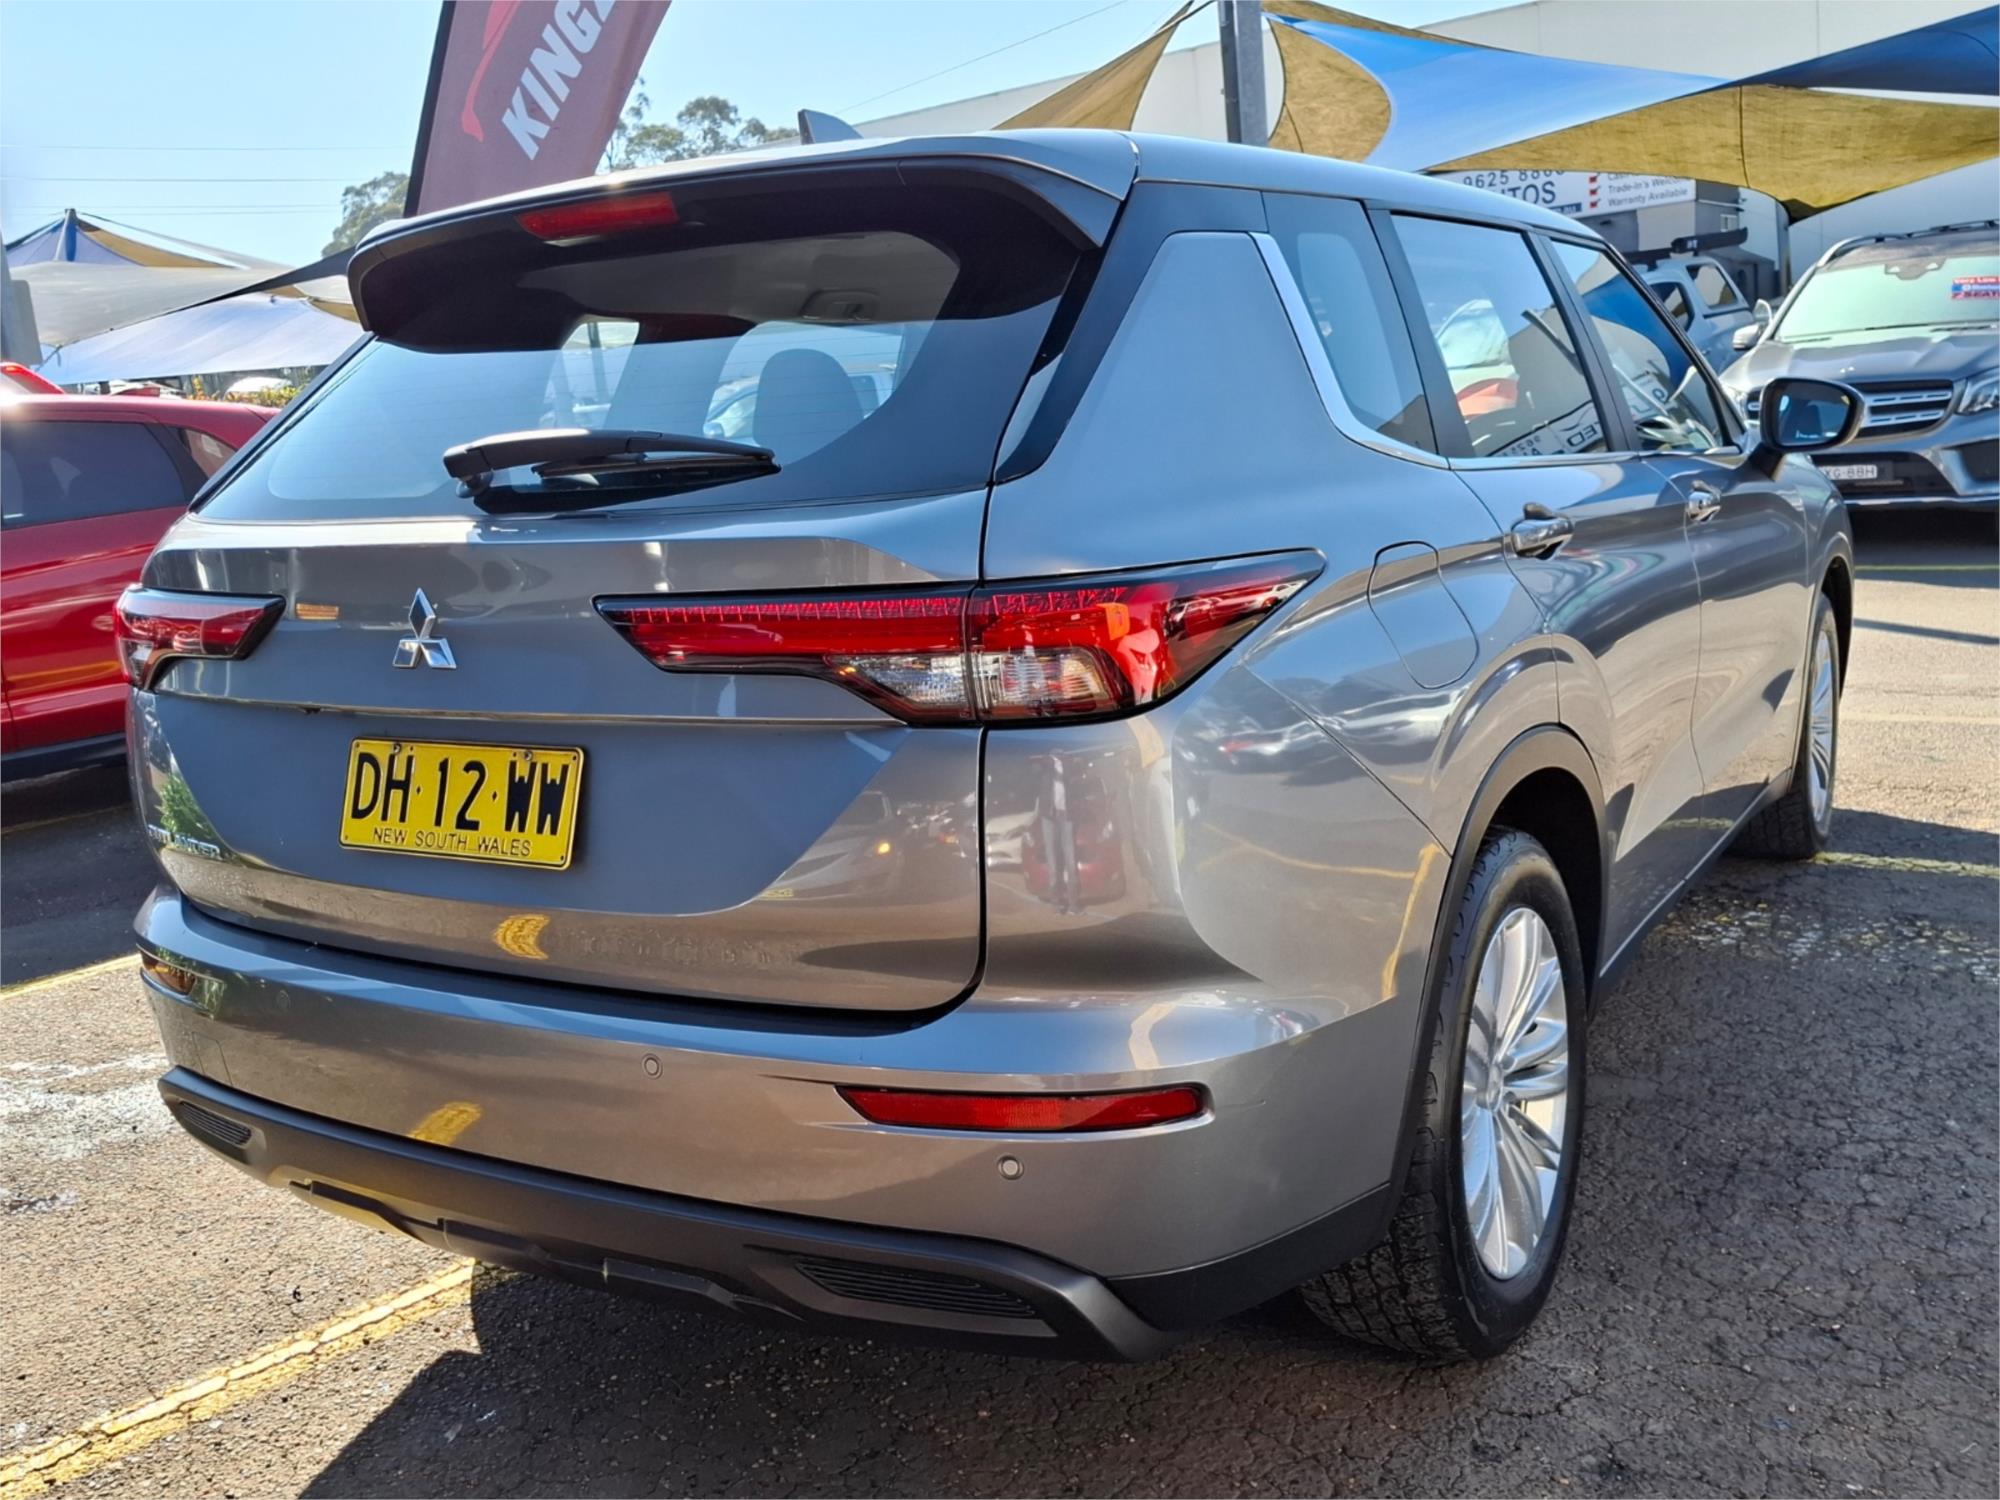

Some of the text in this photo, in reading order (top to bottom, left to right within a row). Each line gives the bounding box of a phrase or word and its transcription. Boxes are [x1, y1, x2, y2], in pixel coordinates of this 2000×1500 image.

[1608, 188, 1688, 207] Warranty Available
[373, 827, 532, 857] NEW SOUTH WALES
